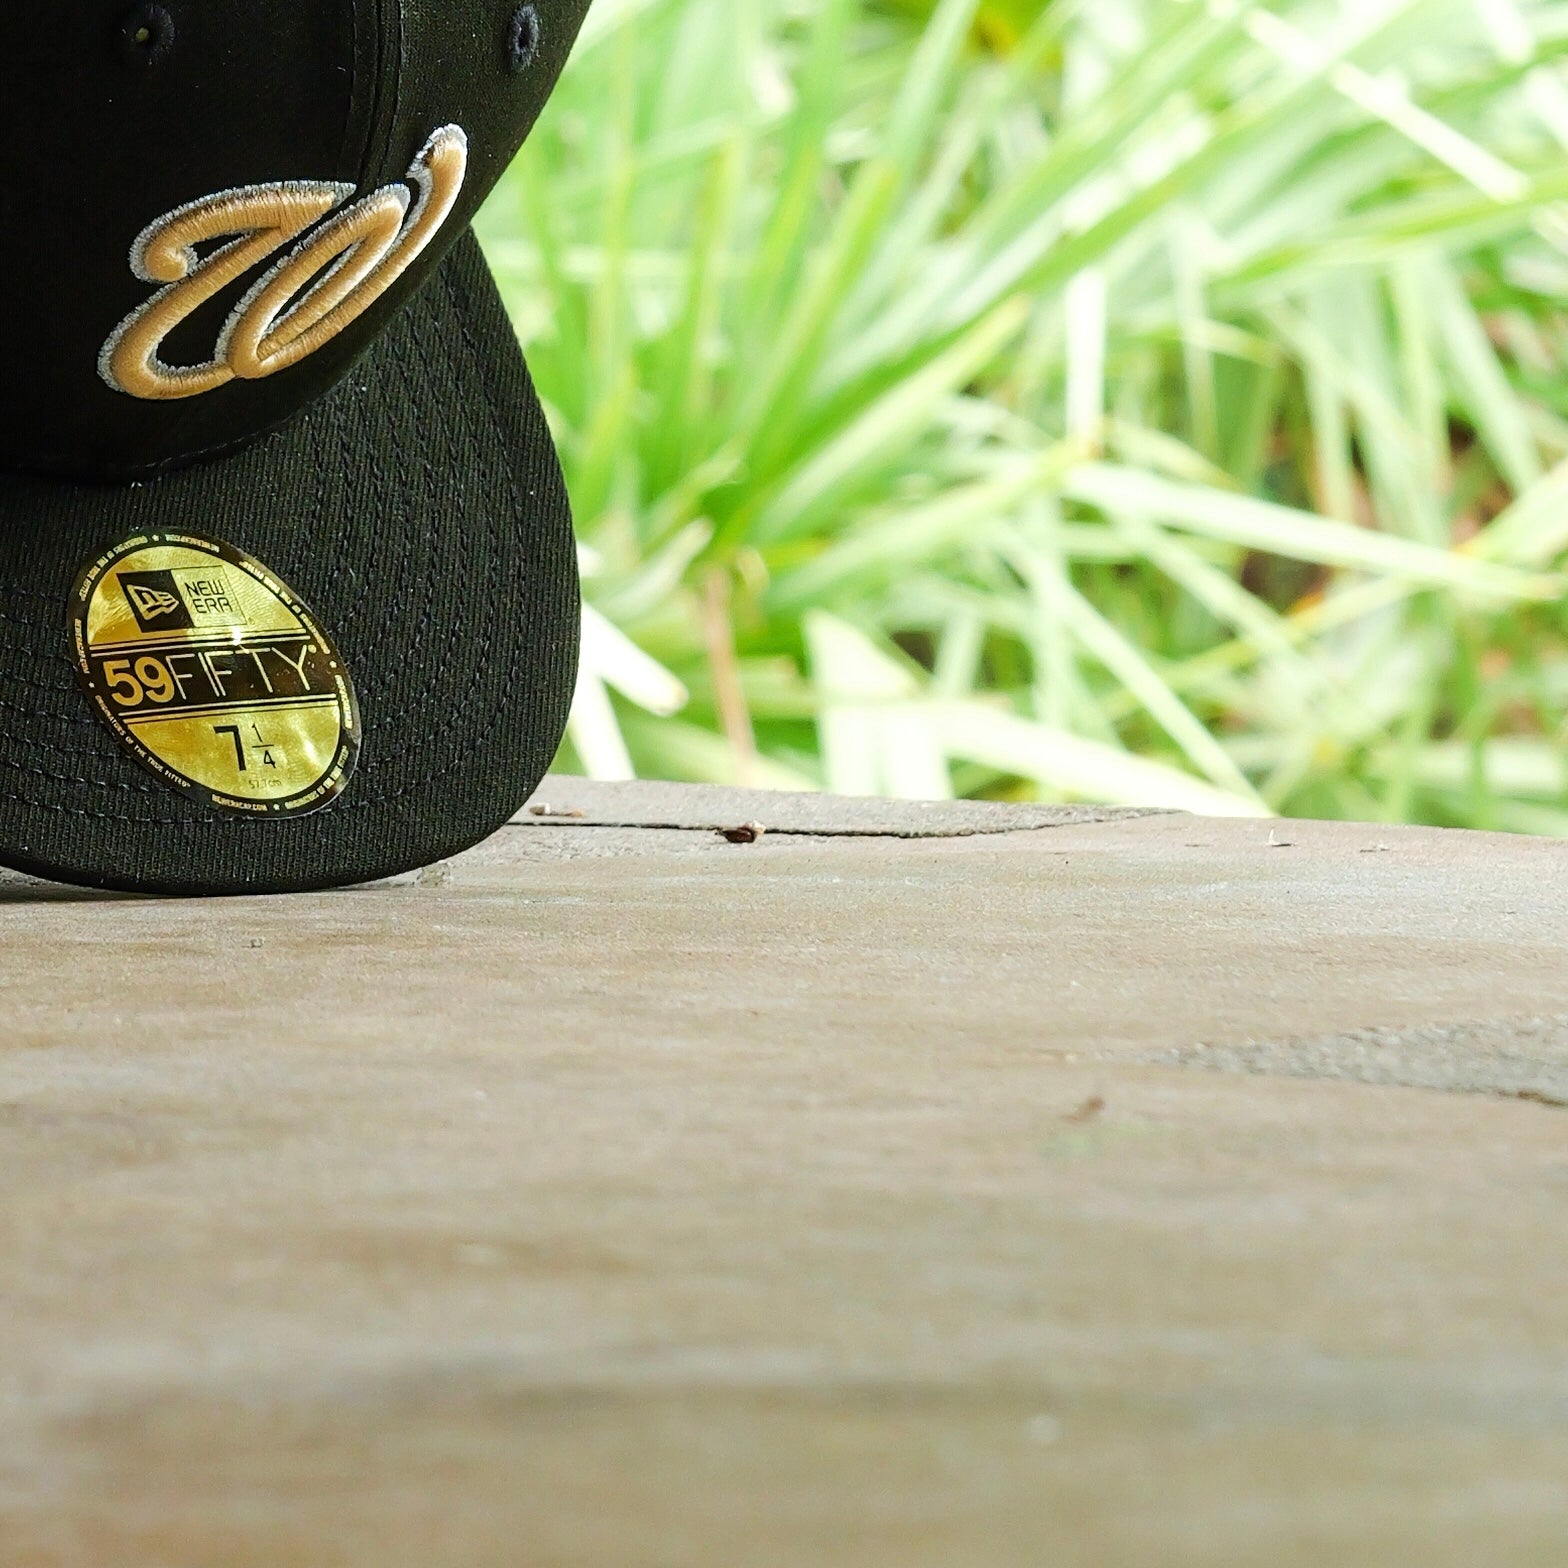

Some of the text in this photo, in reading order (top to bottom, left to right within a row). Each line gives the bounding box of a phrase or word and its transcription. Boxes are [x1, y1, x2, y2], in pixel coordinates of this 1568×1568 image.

[96, 122, 468, 400] W
[184, 579, 225, 597] NEW
[192, 597, 233, 614] ERA
[103, 645, 310, 706] 59FIFTY
[213, 724, 246, 771] 7
